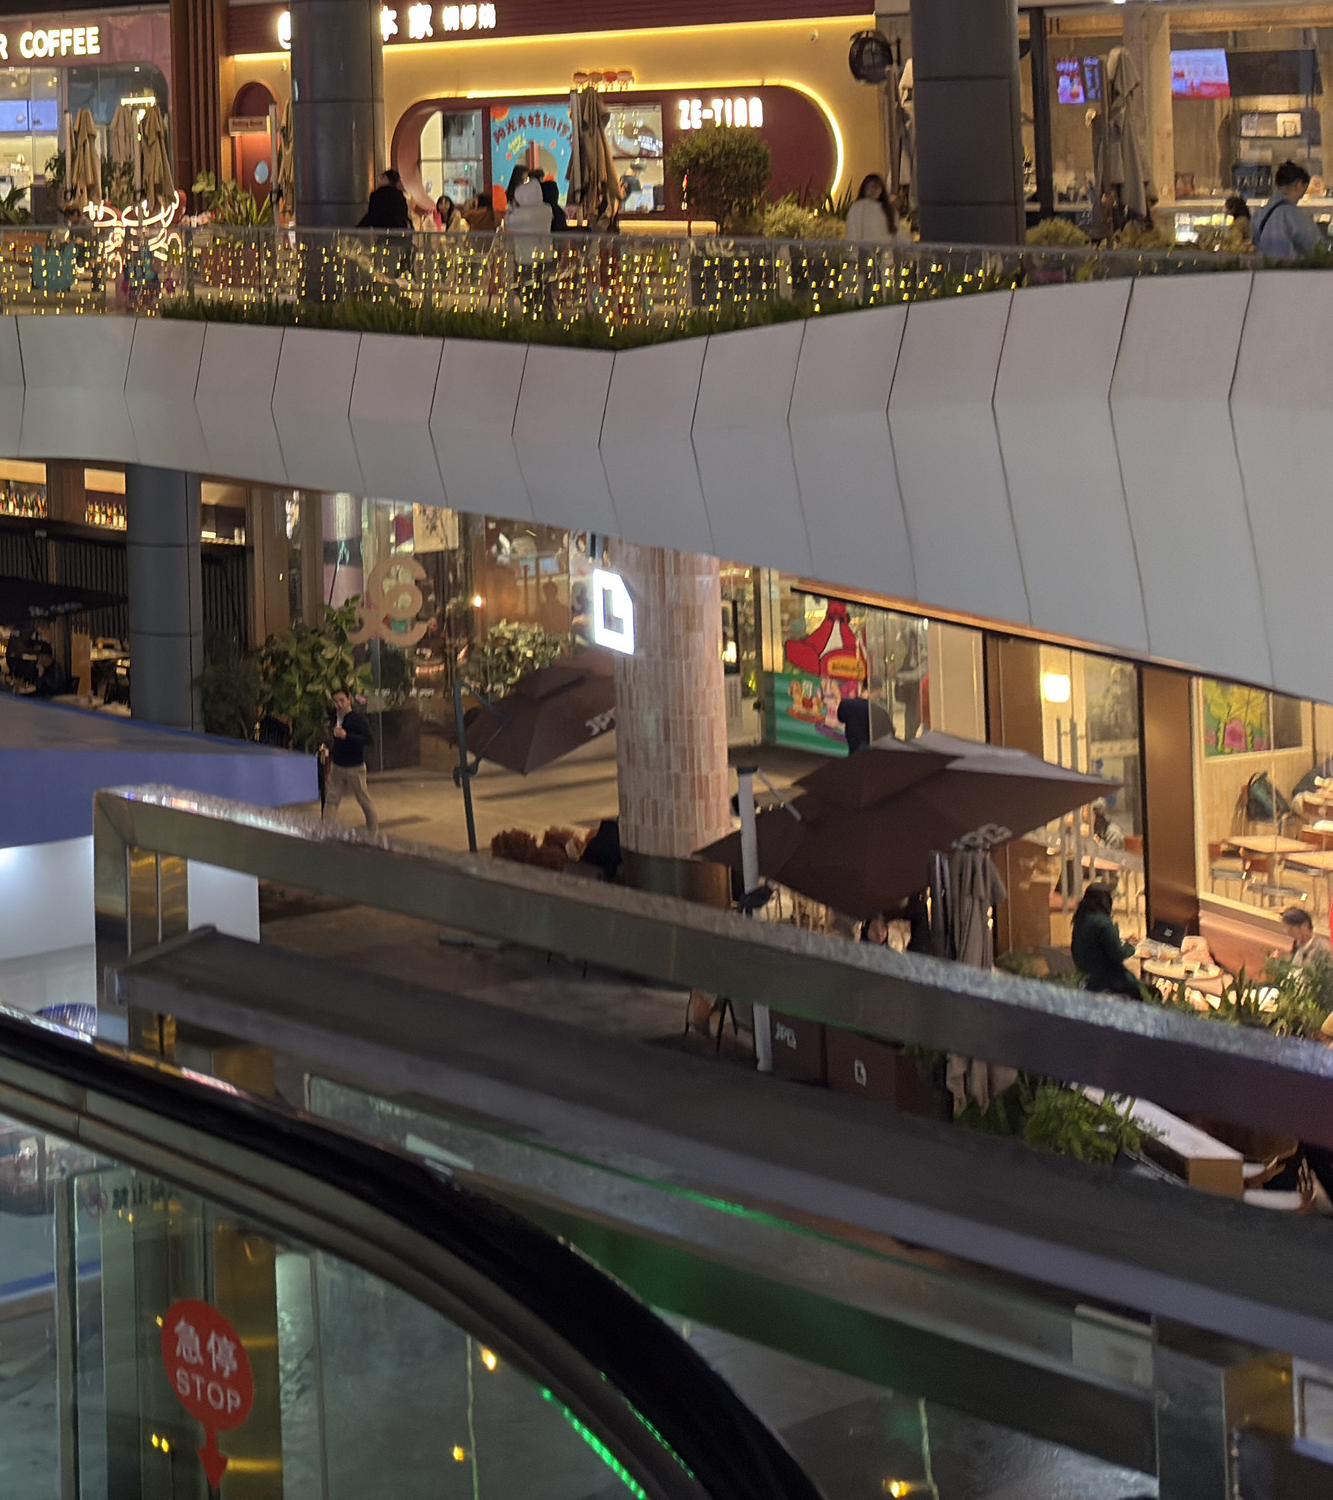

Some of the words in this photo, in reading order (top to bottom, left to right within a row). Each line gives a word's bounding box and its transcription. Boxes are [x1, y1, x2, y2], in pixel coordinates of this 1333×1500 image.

[19, 25, 102, 59] COFFEE
[174, 1316, 238, 1379] 急停
[175, 1370, 242, 1414] STOP
